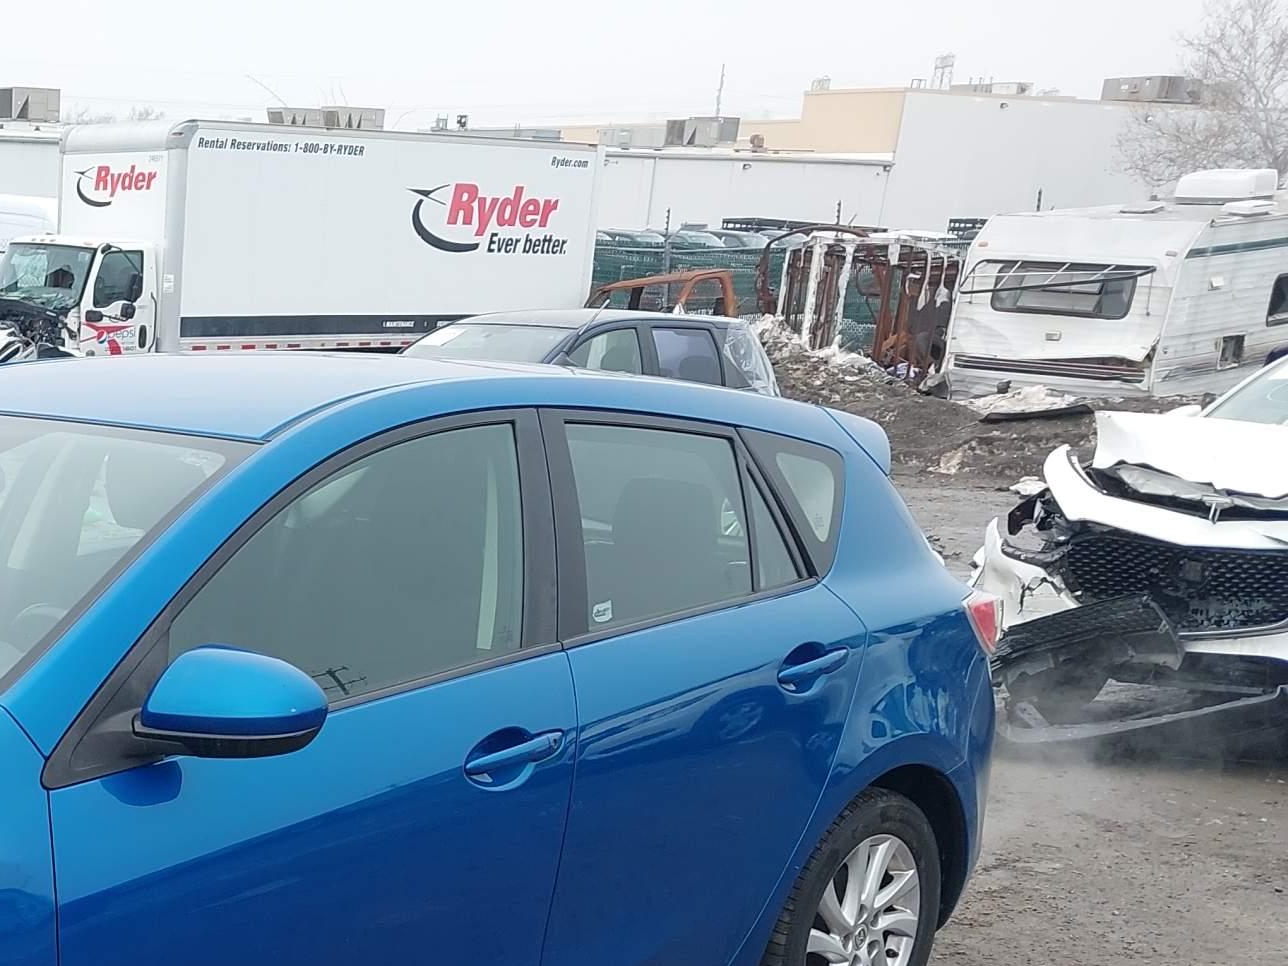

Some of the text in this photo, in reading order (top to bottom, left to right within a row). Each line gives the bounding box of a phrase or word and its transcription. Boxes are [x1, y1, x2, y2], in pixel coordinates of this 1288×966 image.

[197, 137, 365, 157] Rental Reservations: 1-800-BY-RYDER
[551, 156, 589, 169] Ryder.com
[94, 164, 158, 198] Ryder
[446, 183, 560, 237] Ryder
[487, 232, 568, 255] Ever better.
